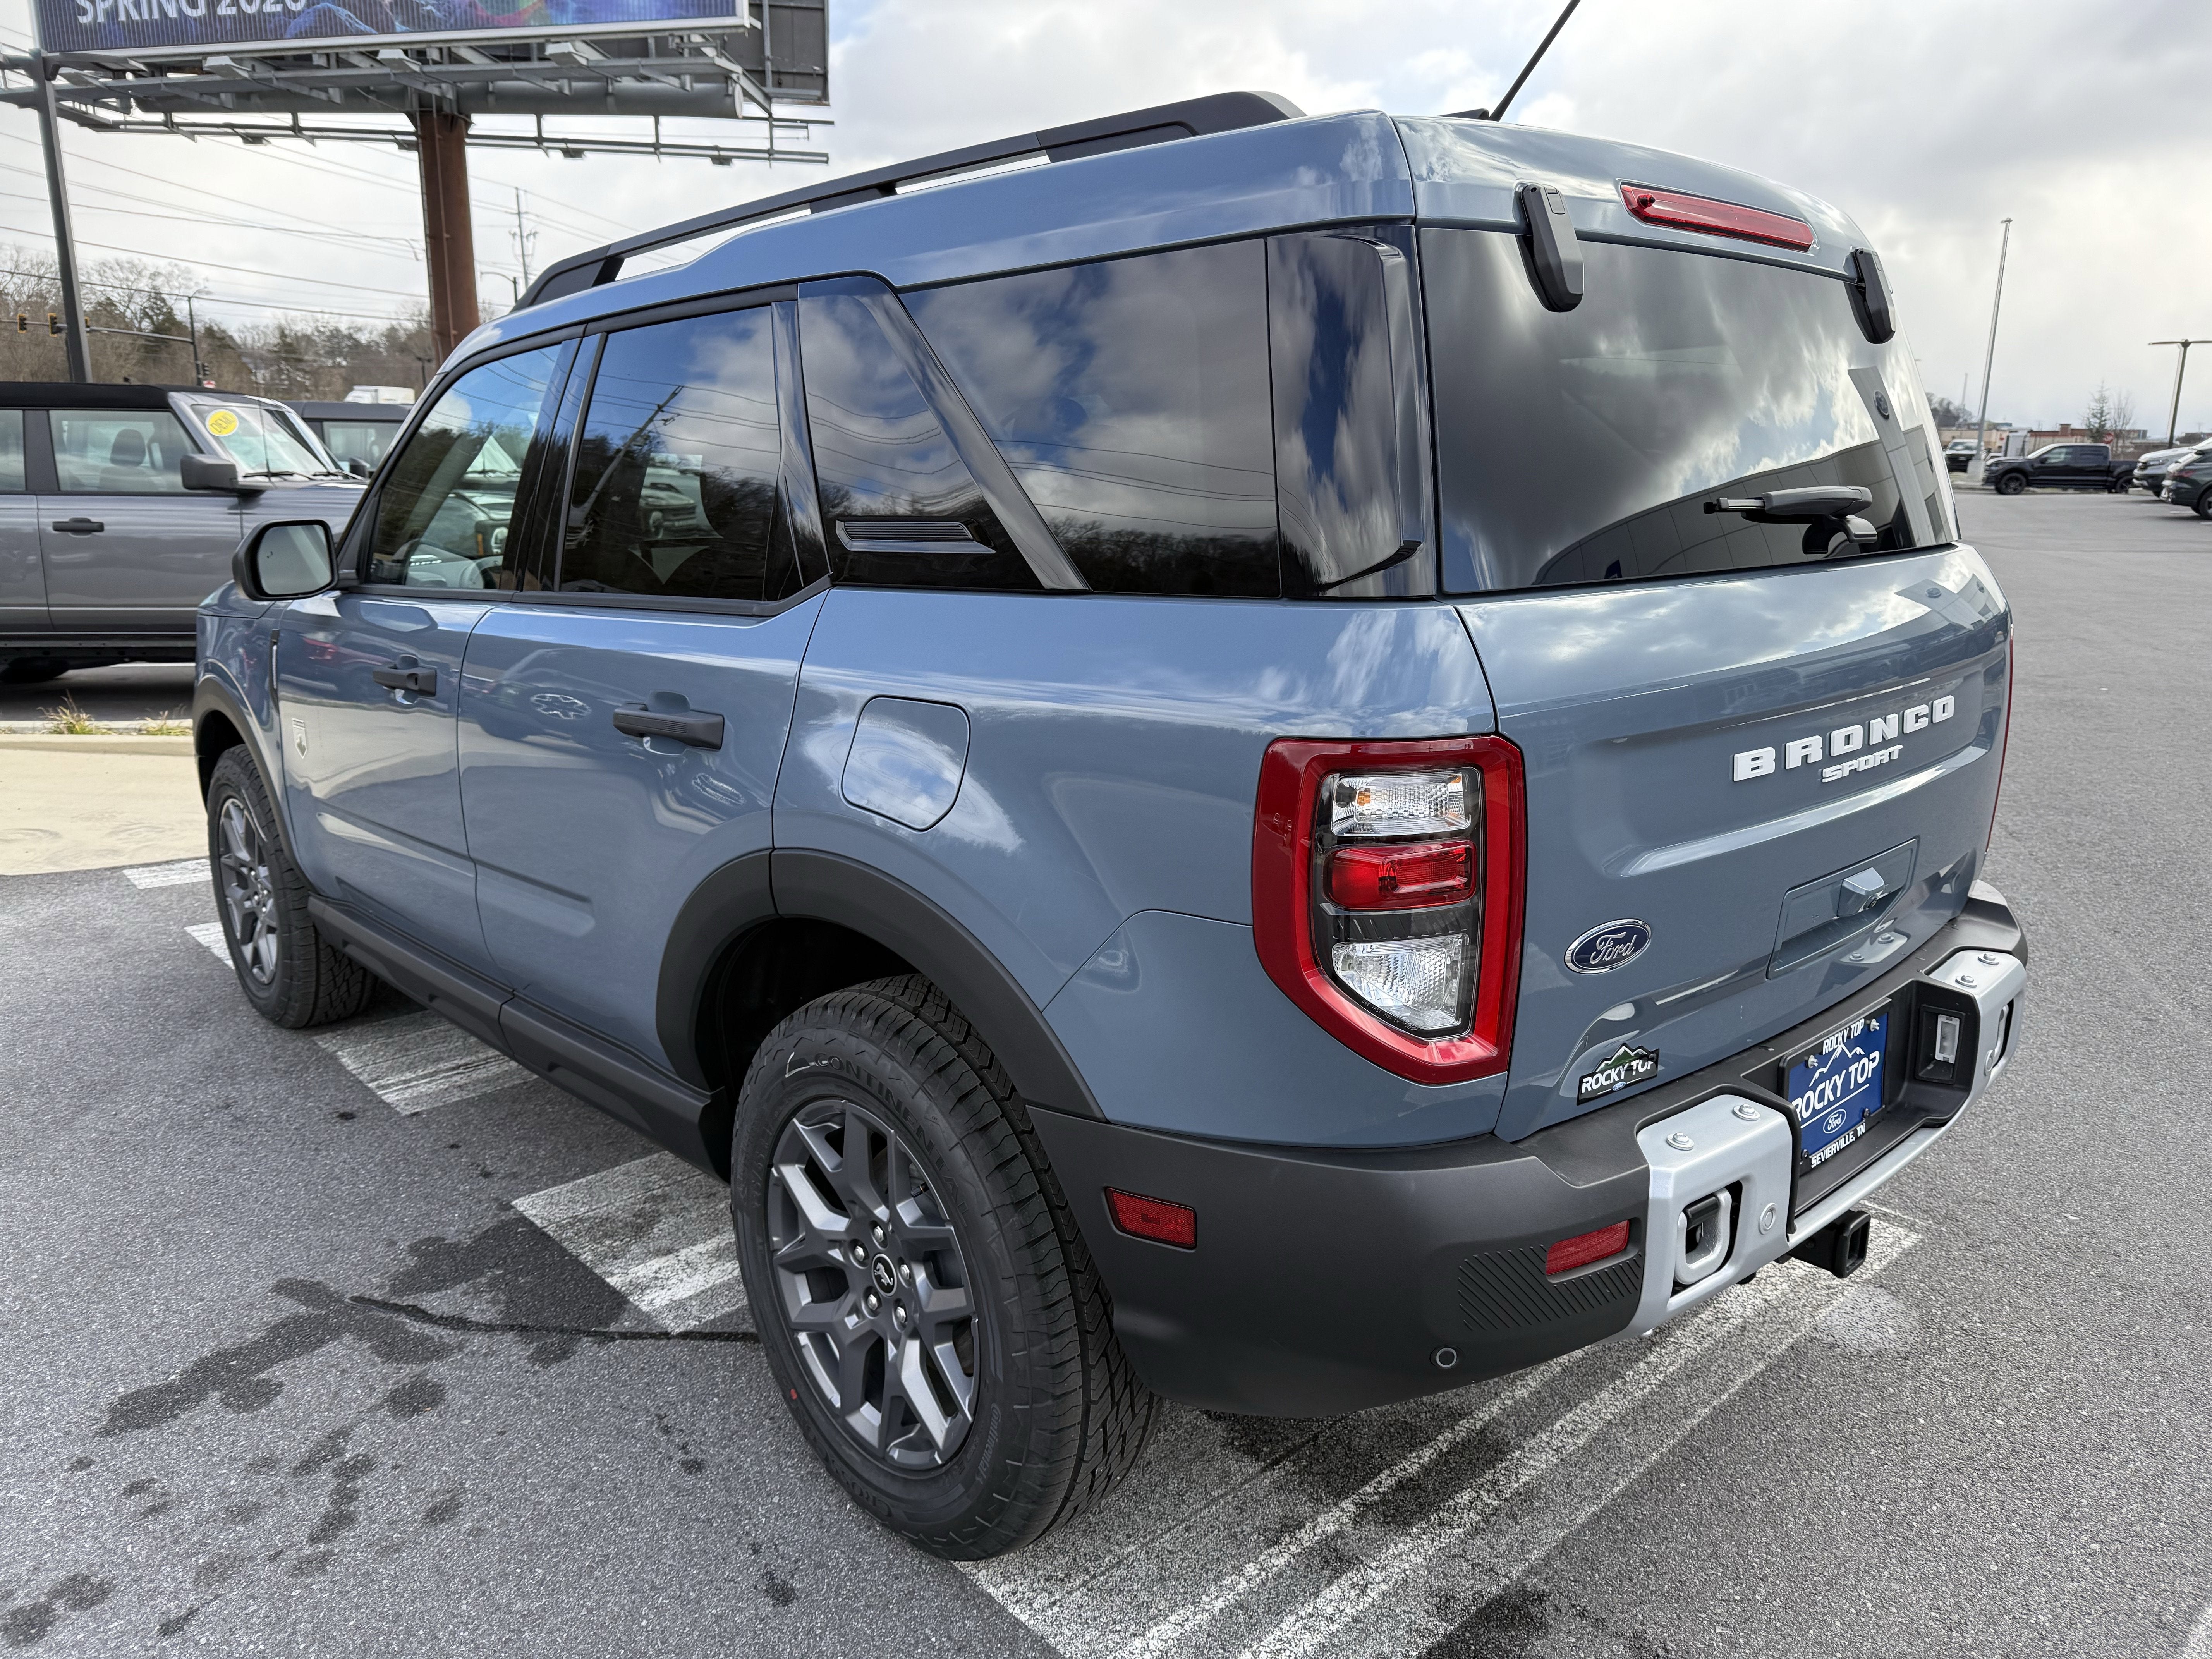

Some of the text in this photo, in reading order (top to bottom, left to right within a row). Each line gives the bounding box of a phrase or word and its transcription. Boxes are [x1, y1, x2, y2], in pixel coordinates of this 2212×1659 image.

[1733, 695, 1954, 781] BRONCO
[1822, 744, 1903, 783] SPORT
[1590, 931, 1637, 965] Ford
[1823, 1018, 1865, 1055] ROCKY TOP
[1581, 1063, 1629, 1094] ROCKY
[1792, 1051, 1879, 1121] ROCKY TOP
[1827, 1113, 1843, 1130] Ford
[1811, 1123, 1865, 1168] SEVIERVILLE, TN
